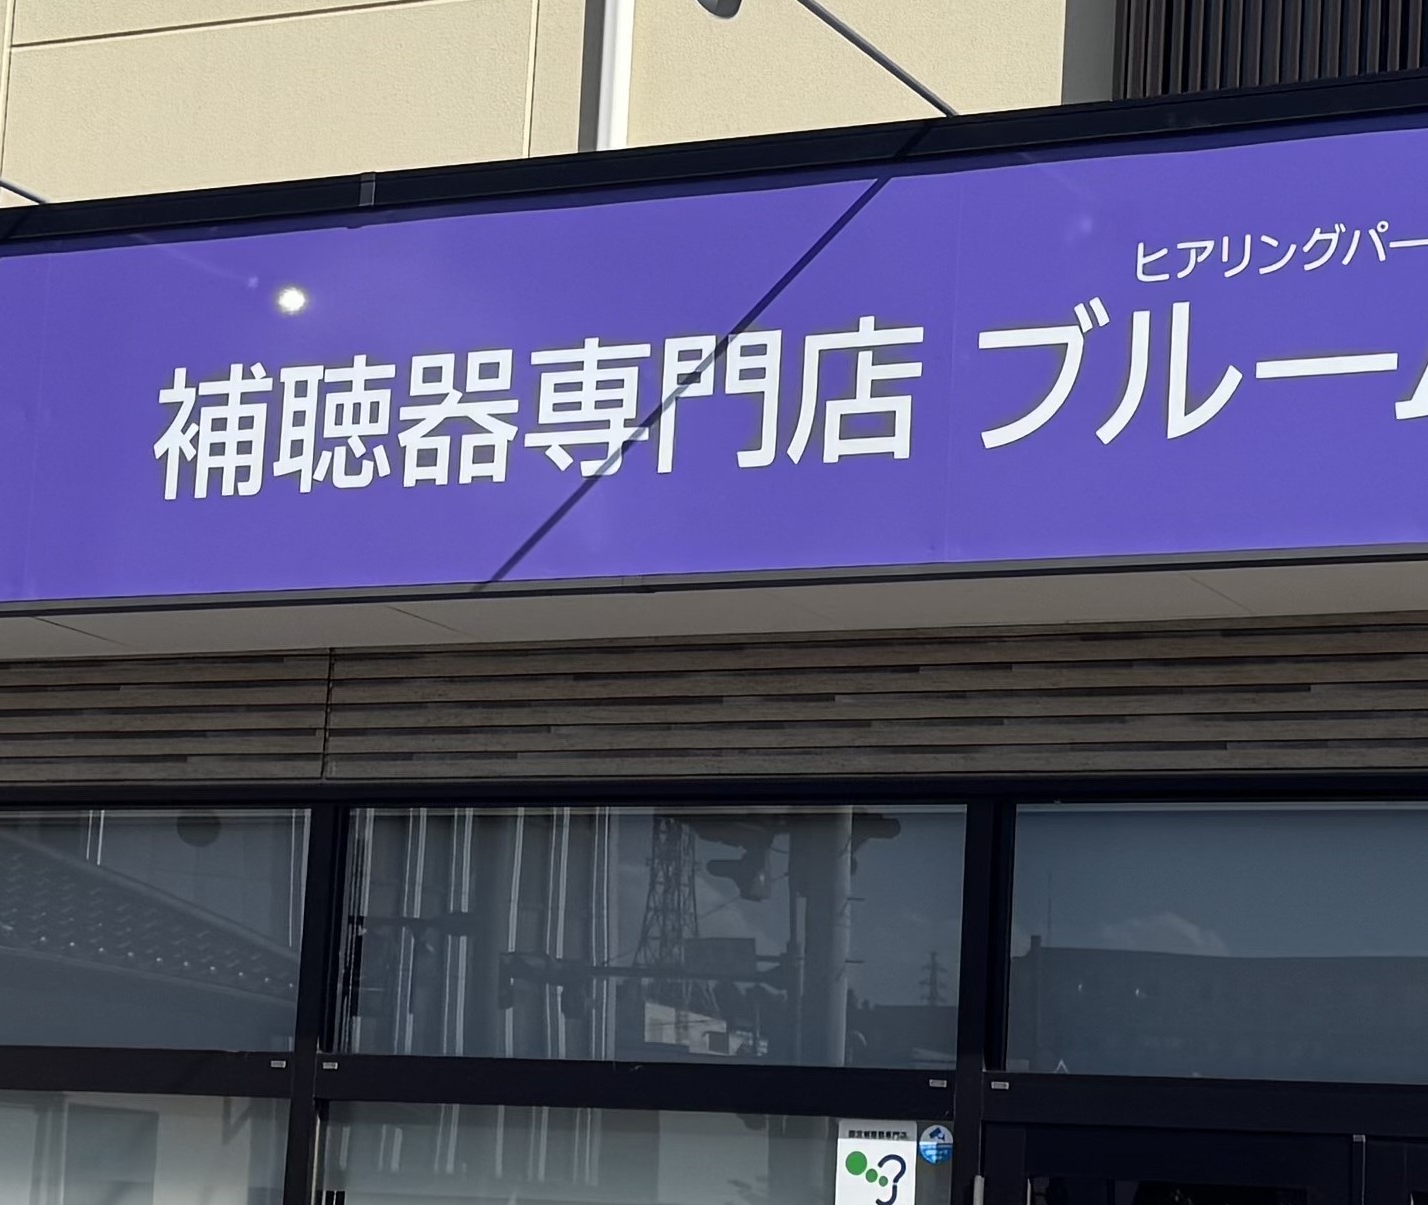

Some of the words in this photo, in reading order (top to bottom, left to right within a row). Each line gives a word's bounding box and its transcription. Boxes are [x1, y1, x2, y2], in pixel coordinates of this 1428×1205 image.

[153, 315, 924, 500] 補聴器専門店
